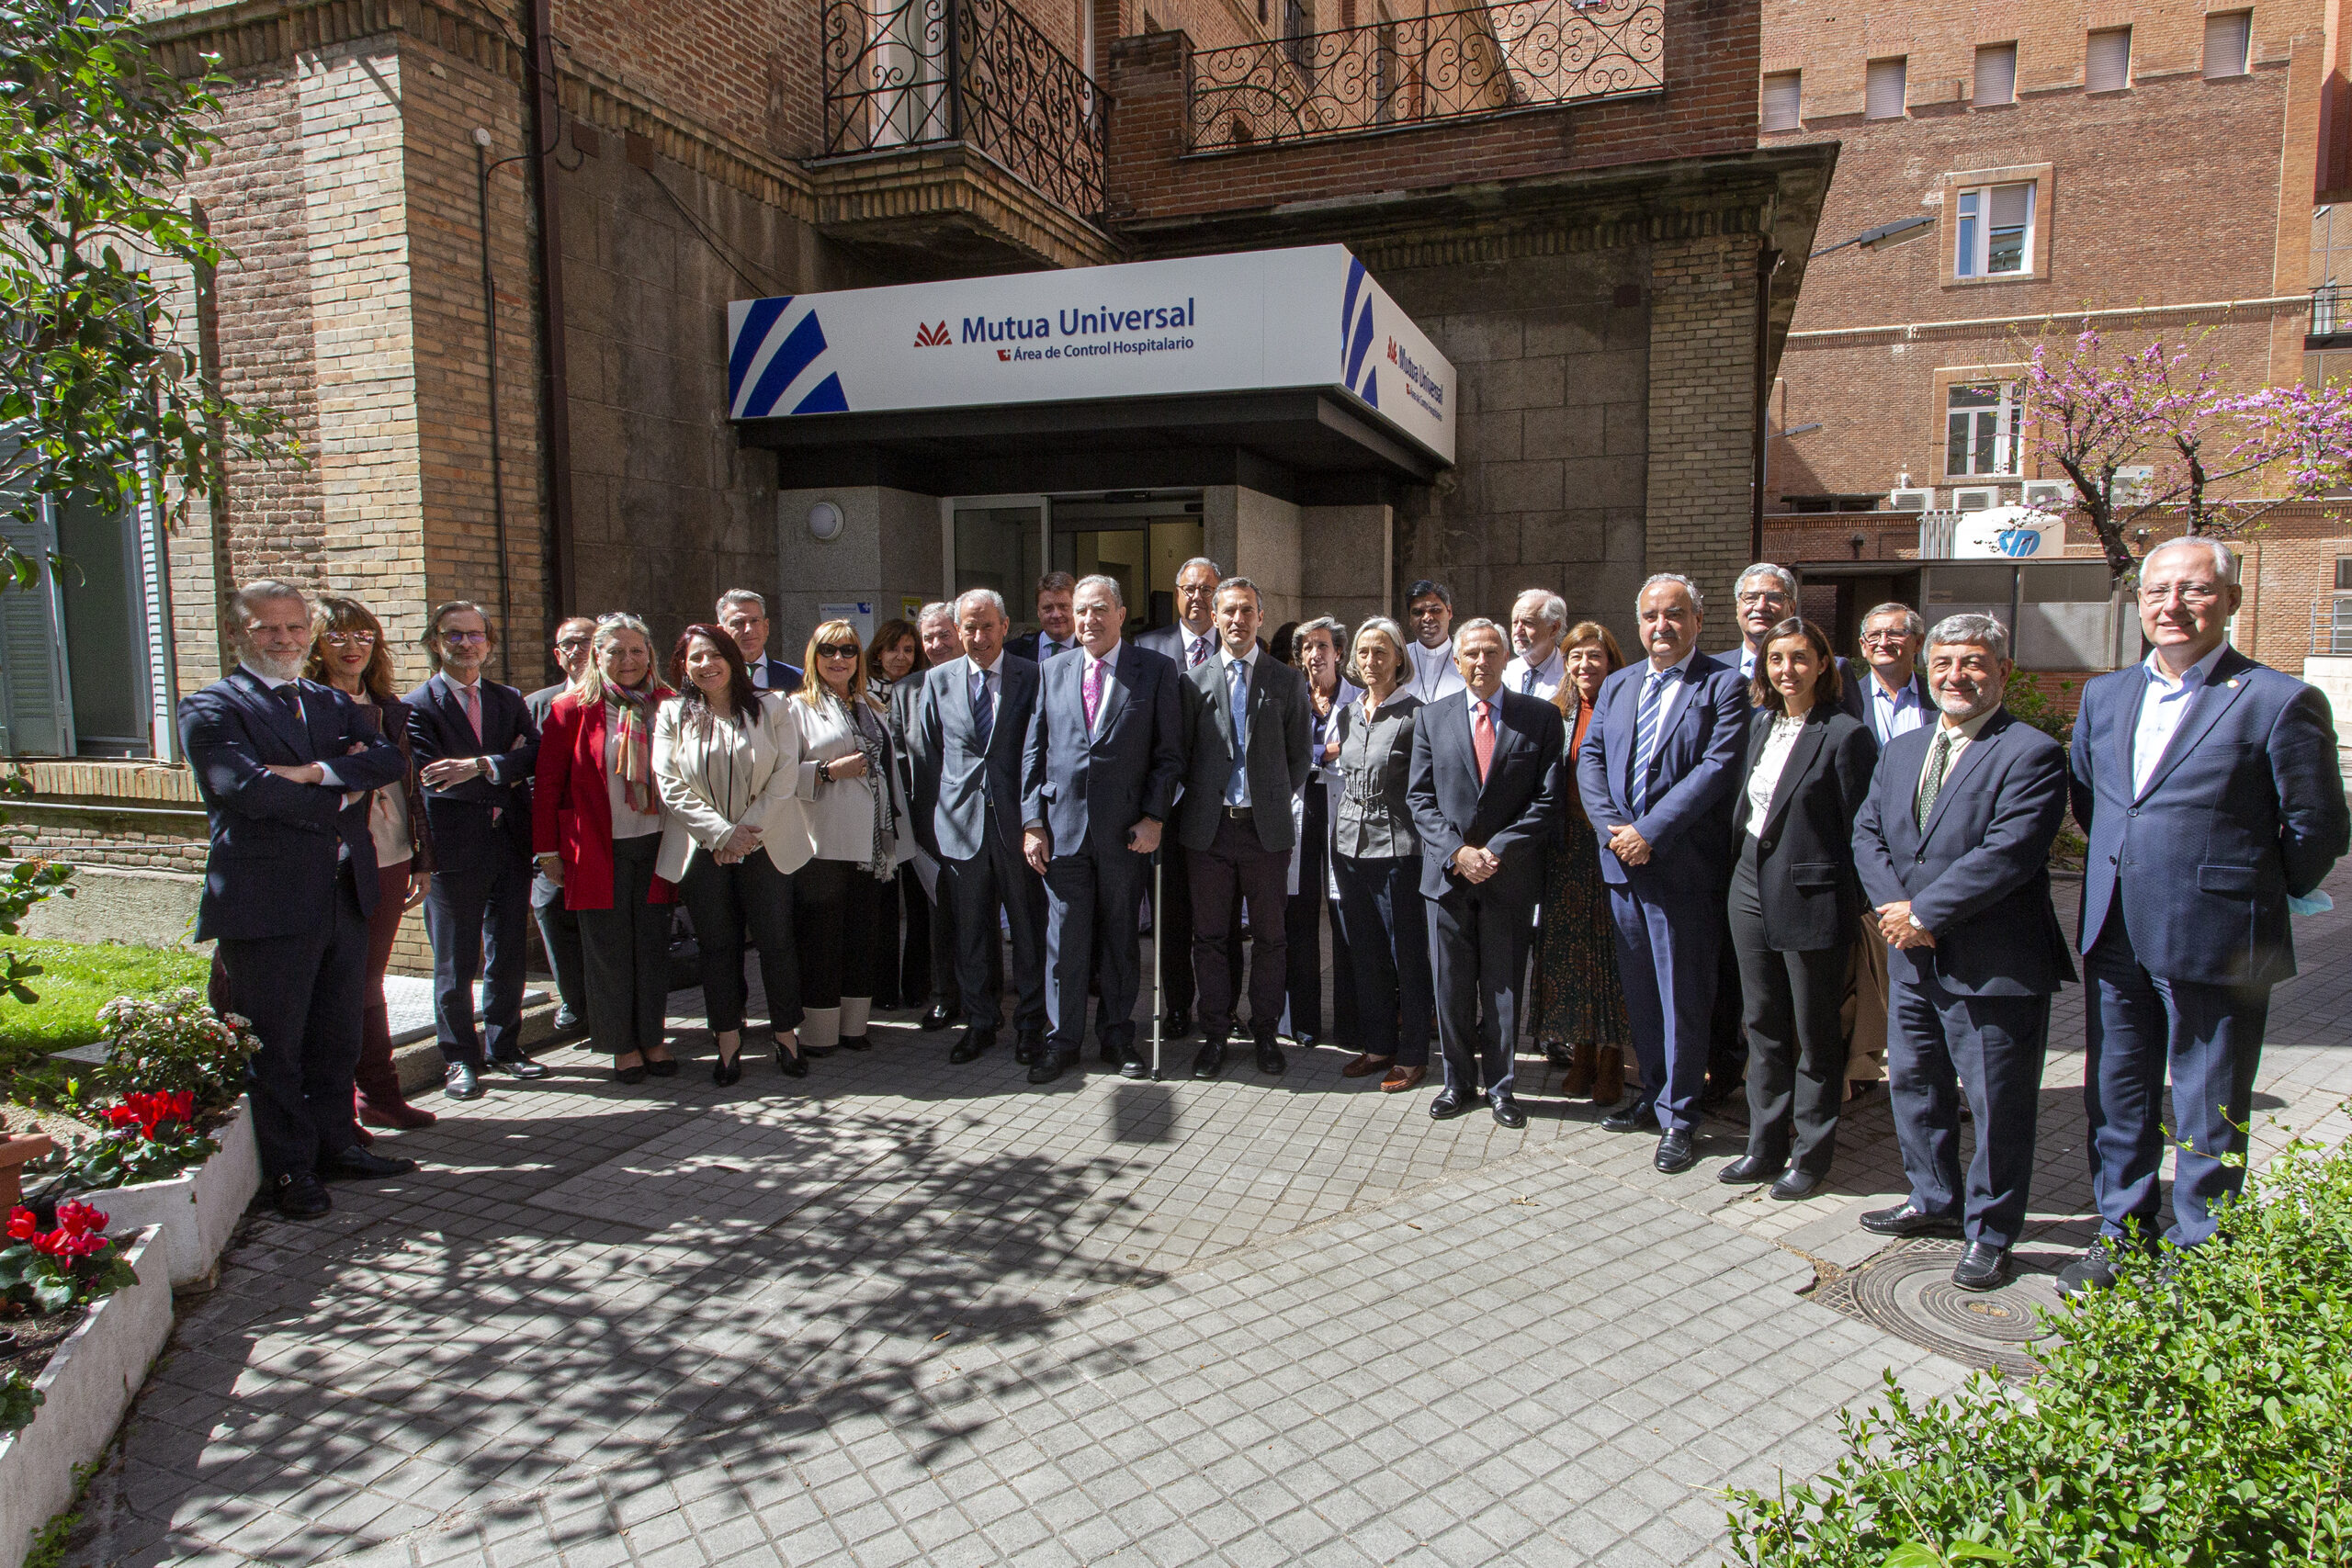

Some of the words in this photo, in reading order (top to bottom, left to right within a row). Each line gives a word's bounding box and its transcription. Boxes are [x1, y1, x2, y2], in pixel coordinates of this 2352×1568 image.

[962, 316, 1049, 344] Mutua
[1059, 298, 1194, 336] Universal
[1013, 346, 1042, 362] Área
[1046, 345, 1060, 359] de
[1064, 342, 1111, 358] Control
[1114, 336, 1194, 355] Hospitalario
